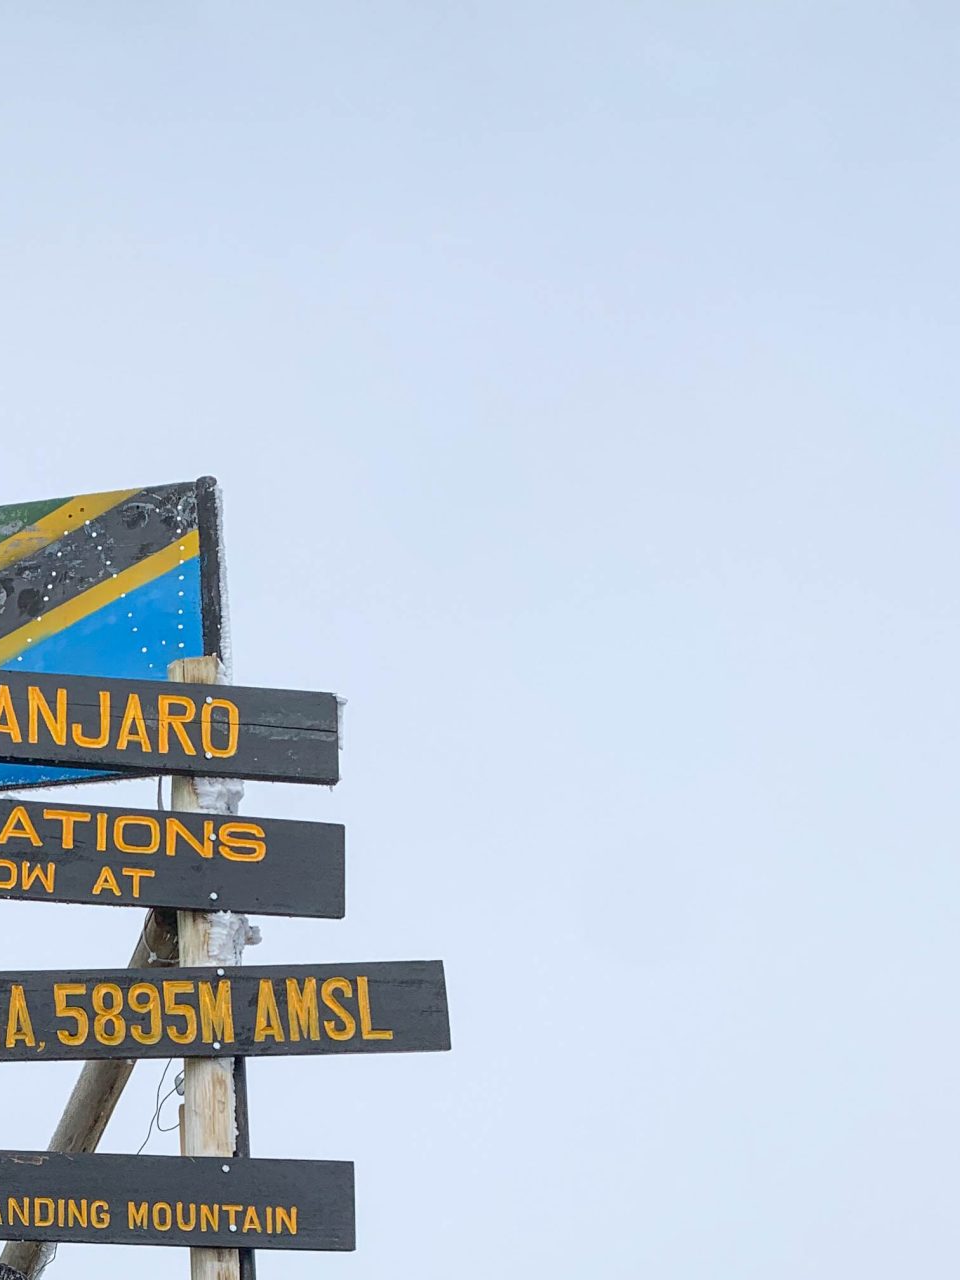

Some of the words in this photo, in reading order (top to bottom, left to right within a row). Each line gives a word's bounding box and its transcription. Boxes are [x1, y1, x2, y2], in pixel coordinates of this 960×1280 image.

[92, 866, 155, 896] AT
[54, 980, 234, 1046] 5895M
[254, 976, 393, 1041] AMSL
[128, 1201, 297, 1233] MOUNTAIN
